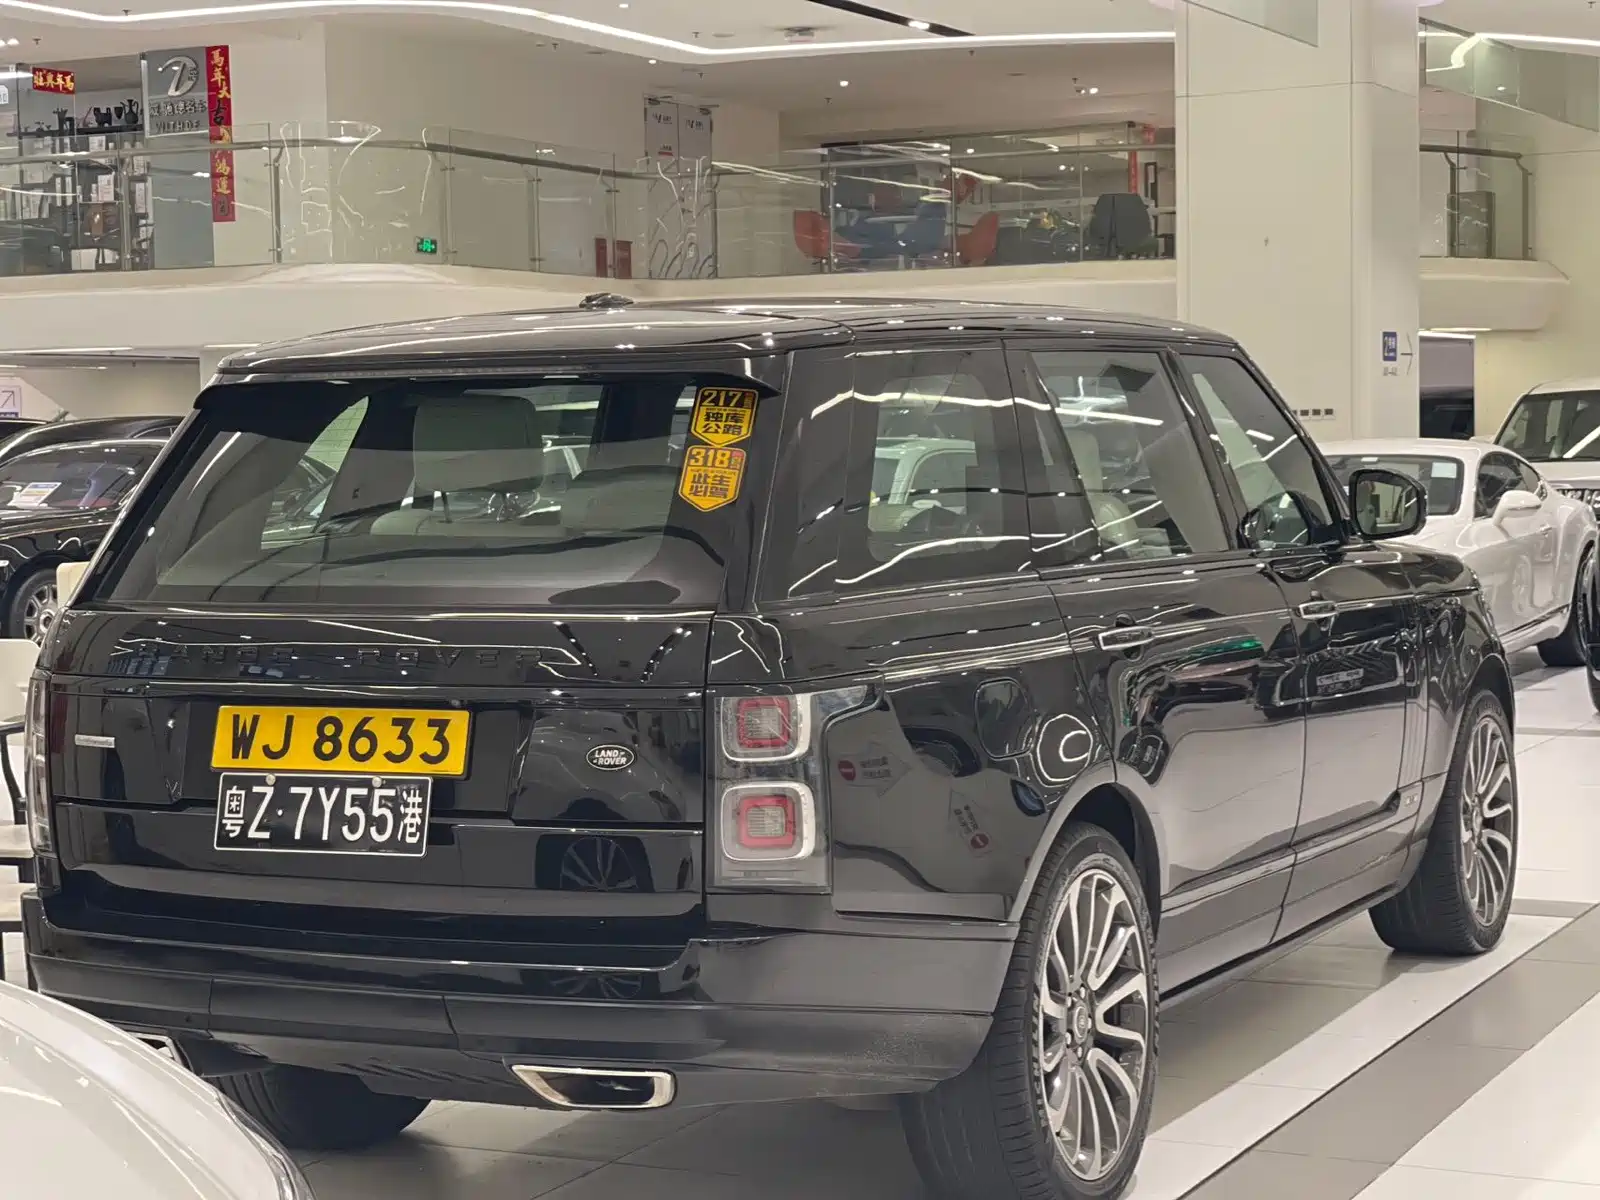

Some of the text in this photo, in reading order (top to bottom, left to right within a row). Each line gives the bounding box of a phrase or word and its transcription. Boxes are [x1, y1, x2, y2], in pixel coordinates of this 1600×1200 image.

[701, 389, 743, 407] 217
[701, 423, 742, 436] 公路
[688, 448, 732, 468] 318
[231, 713, 453, 765] WJ 8633
